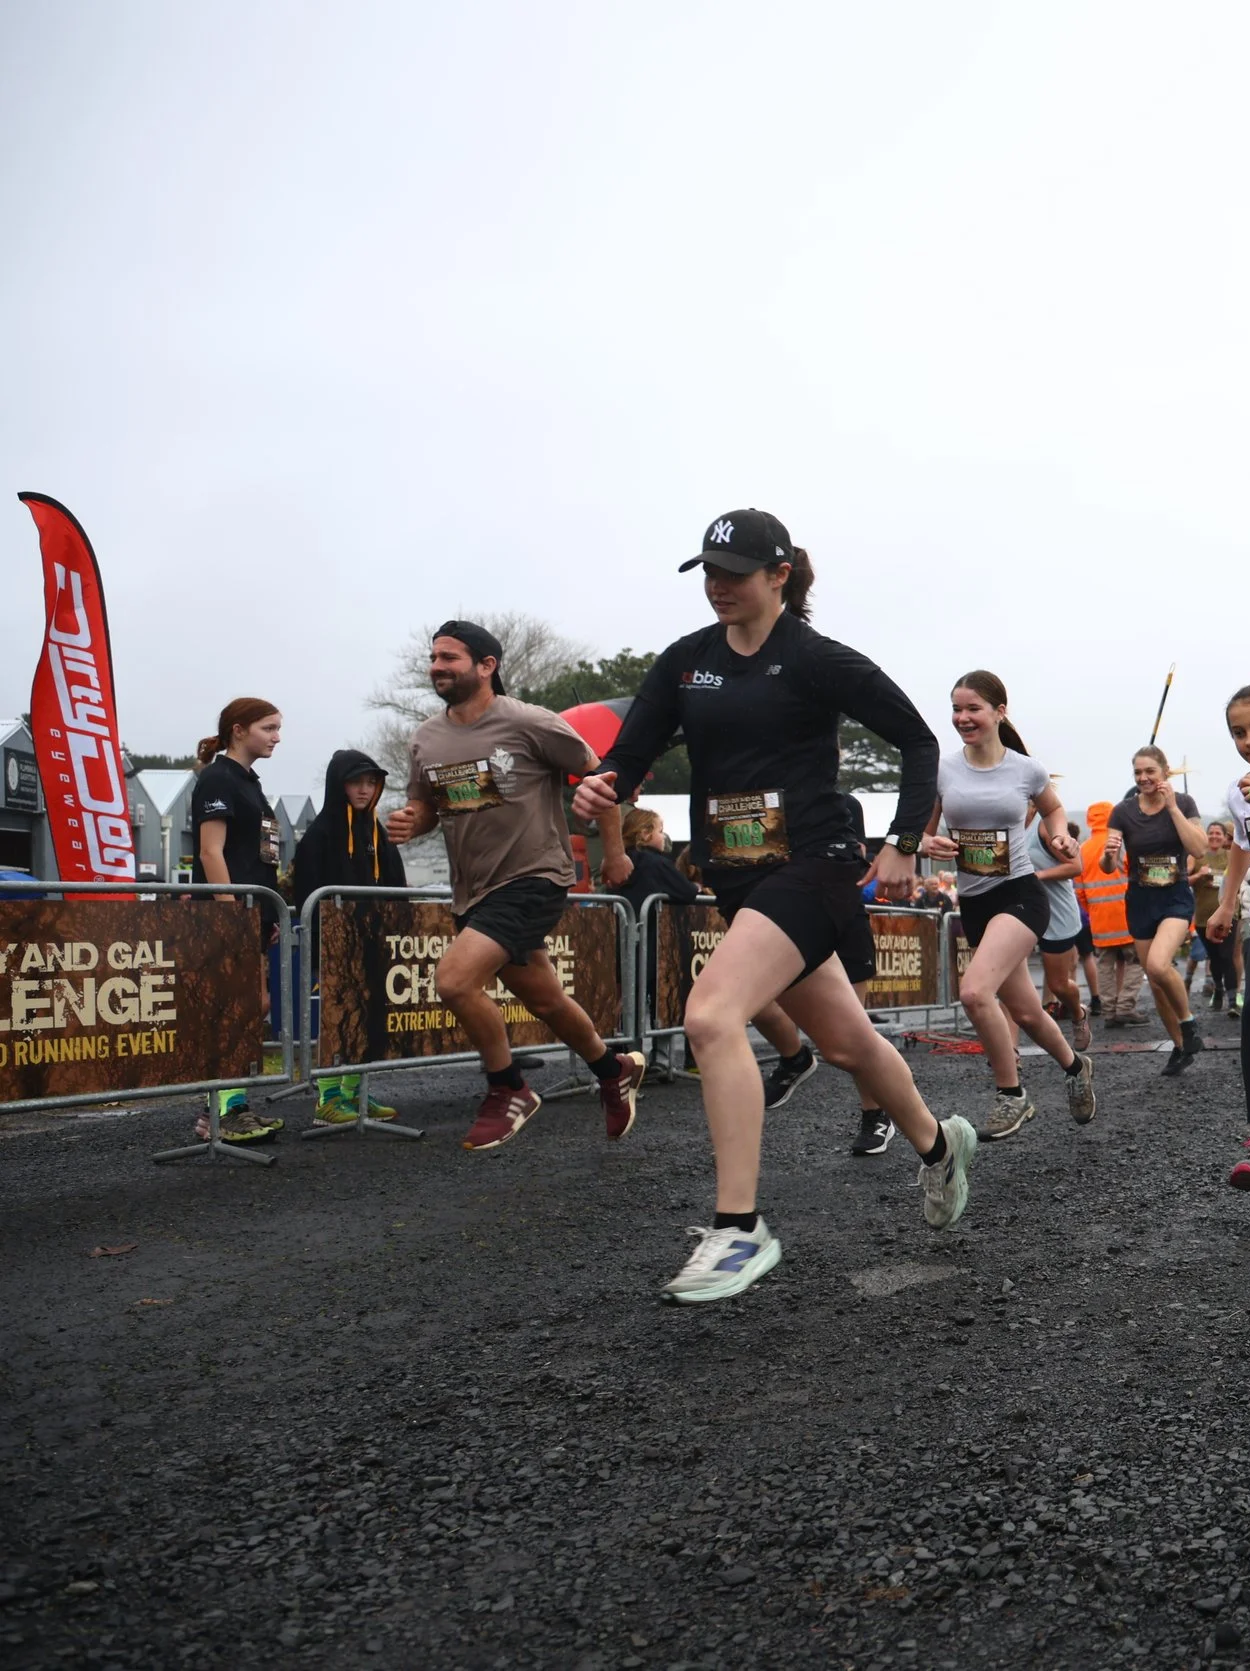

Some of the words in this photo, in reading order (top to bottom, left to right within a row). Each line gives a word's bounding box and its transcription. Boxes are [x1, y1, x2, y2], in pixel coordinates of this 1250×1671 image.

[710, 520, 735, 543] NY
[719, 801, 764, 813] CHALLENGE
[20, 942, 99, 973] AND
[107, 940, 175, 970] GAL
[387, 1010, 442, 1032] EXTREME
[15, 1035, 110, 1066] RUNNING
[118, 1030, 176, 1057] EVENT
